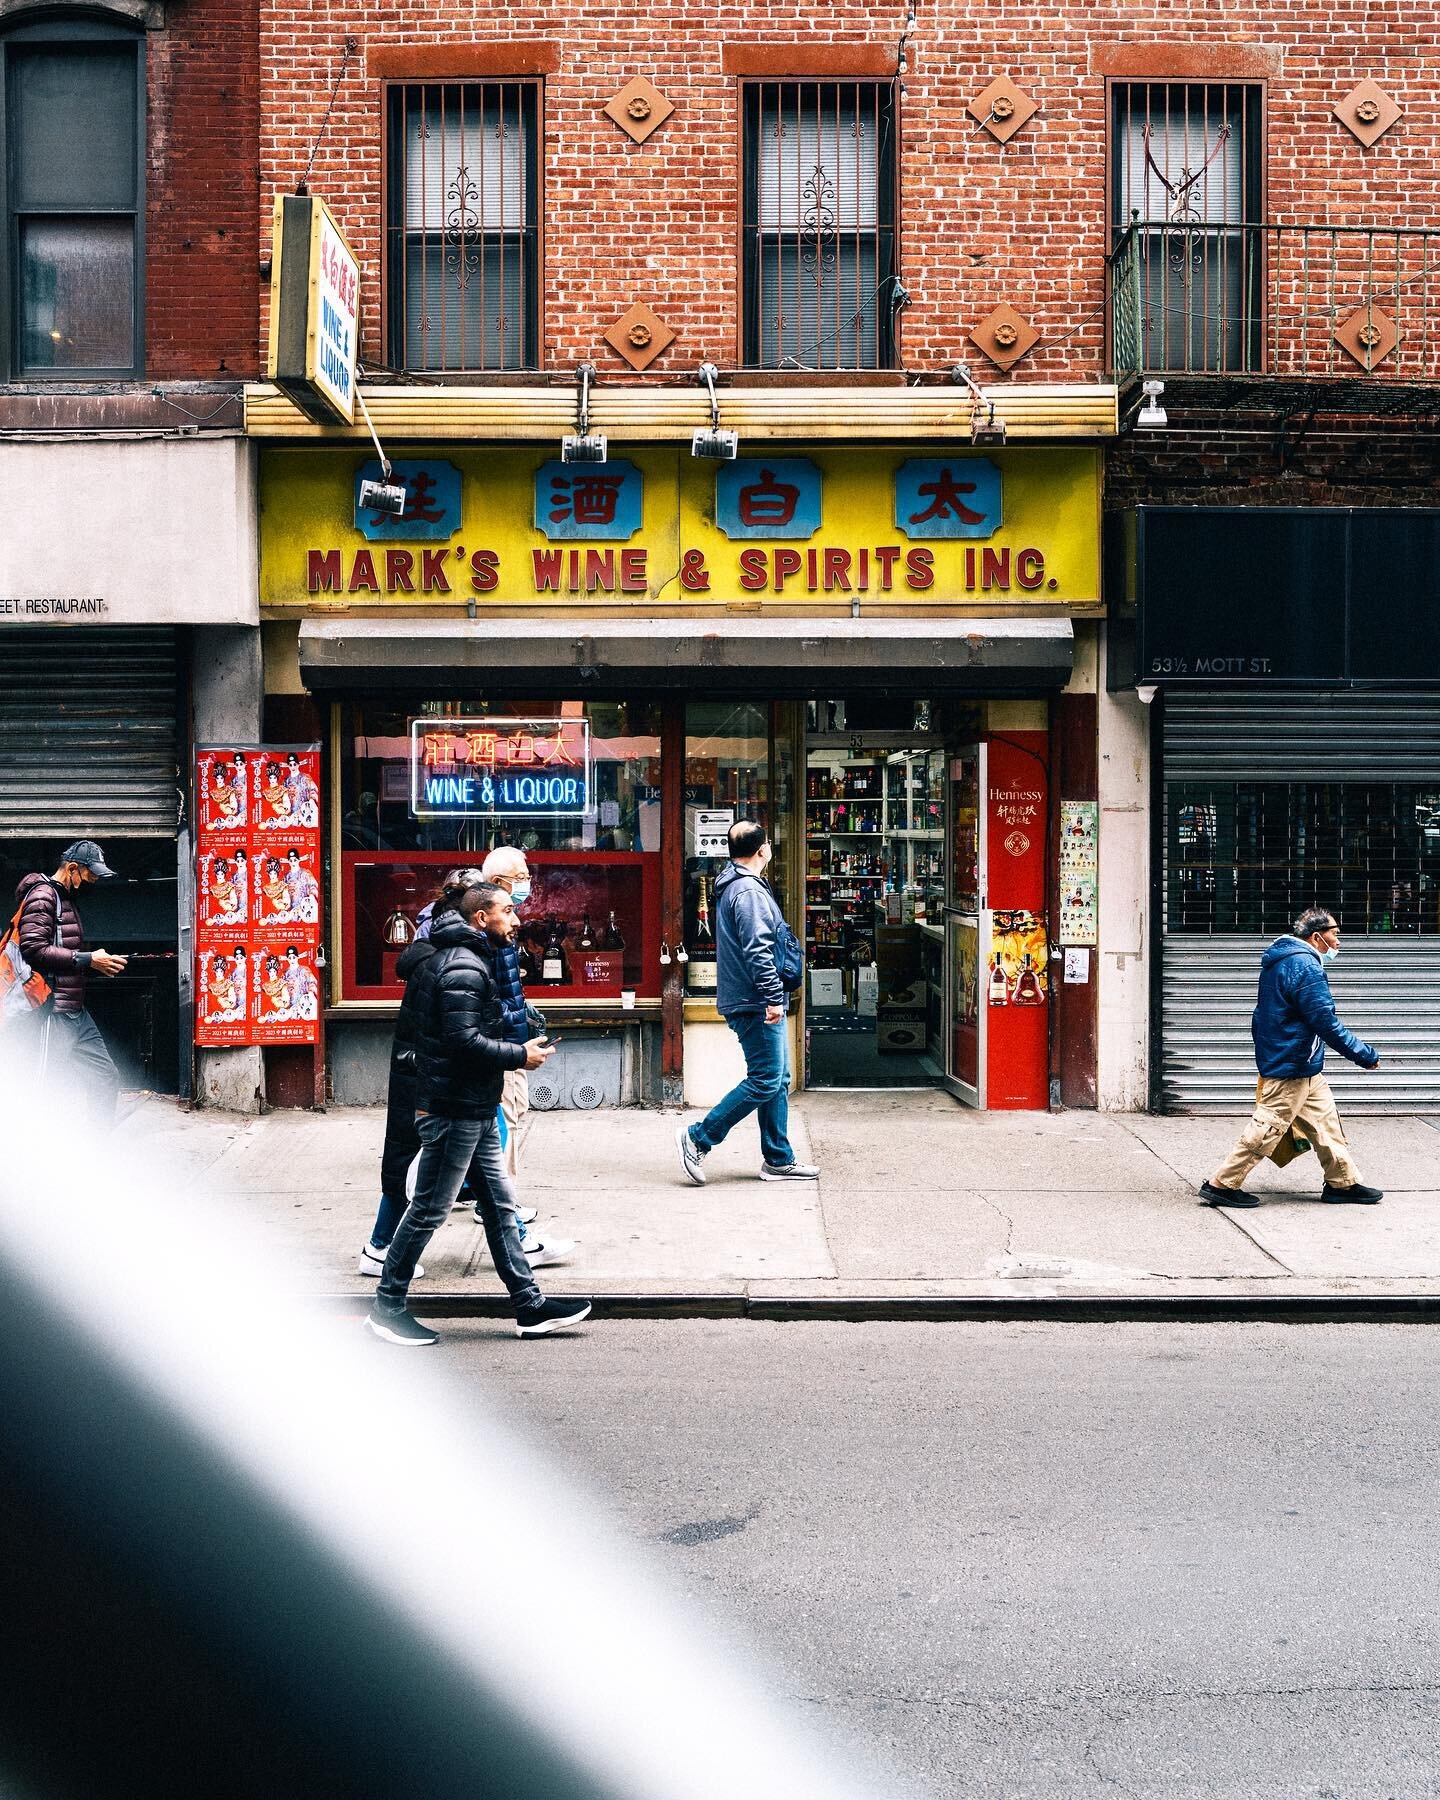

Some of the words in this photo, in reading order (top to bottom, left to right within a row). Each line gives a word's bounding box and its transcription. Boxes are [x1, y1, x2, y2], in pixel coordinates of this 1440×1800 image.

[323, 296, 342, 350] WINE
[344, 329, 349, 358] &
[320, 336, 349, 399] LIQUOR
[307, 546, 500, 592] MARK'S
[532, 548, 649, 592] WINE
[680, 548, 710, 591] &
[738, 546, 936, 590] SPIRITS
[964, 547, 1060, 590] INC.
[26, 598, 104, 614] RESTAURANT
[1195, 657, 1245, 673] MOTT
[1250, 658, 1272, 673] ST.
[849, 735, 863, 747] 53
[426, 777, 475, 804] WINE
[482, 777, 495, 804] &
[503, 777, 578, 805] LIQUOR
[645, 787, 697, 801] Hesy
[990, 788, 1044, 803] Hennessy
